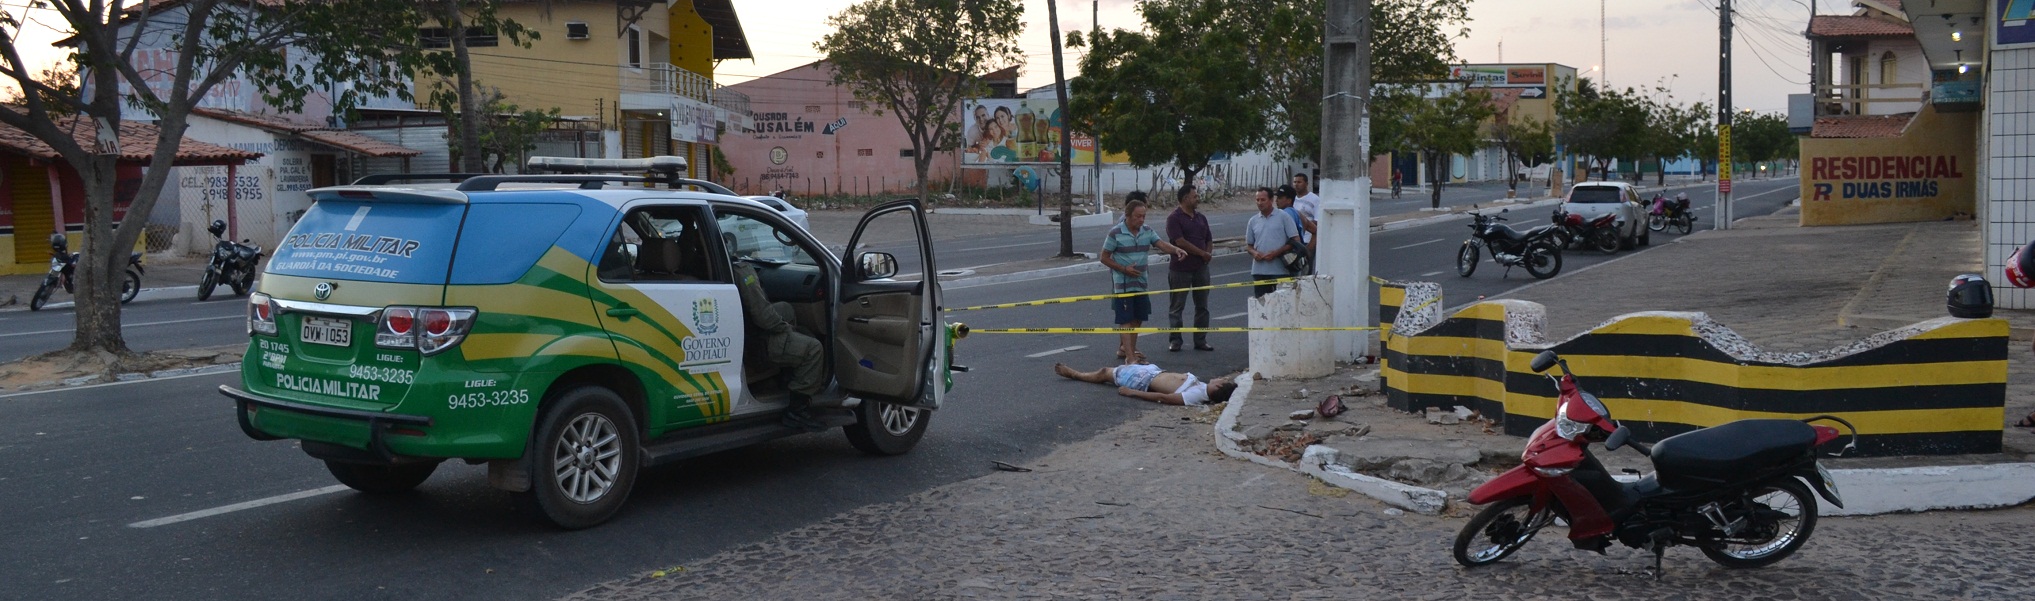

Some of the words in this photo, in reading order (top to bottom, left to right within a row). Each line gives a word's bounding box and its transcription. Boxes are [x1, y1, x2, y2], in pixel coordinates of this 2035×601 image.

[750, 111, 788, 122] OUSADA
[829, 118, 846, 132] AQUI
[1812, 155, 1963, 180] RESIDENCIAL
[1842, 182, 1891, 199] DUAS
[340, 233, 421, 259] MILITAR
[291, 250, 388, 264] www.pm.pi.gov.br
[317, 262, 331, 271] DA
[333, 263, 399, 279] SOCIEDADE
[259, 339, 269, 350] 20
[270, 341, 290, 354] 1745
[682, 336, 731, 351] GOVERNO
[376, 353, 404, 363] LIGUE:
[686, 350, 701, 362] DO
[350, 364, 414, 385] 9453-3235
[323, 380, 381, 400] MILITAR
[464, 379, 497, 388] LIGUE:
[448, 389, 530, 409] 9453-3235
